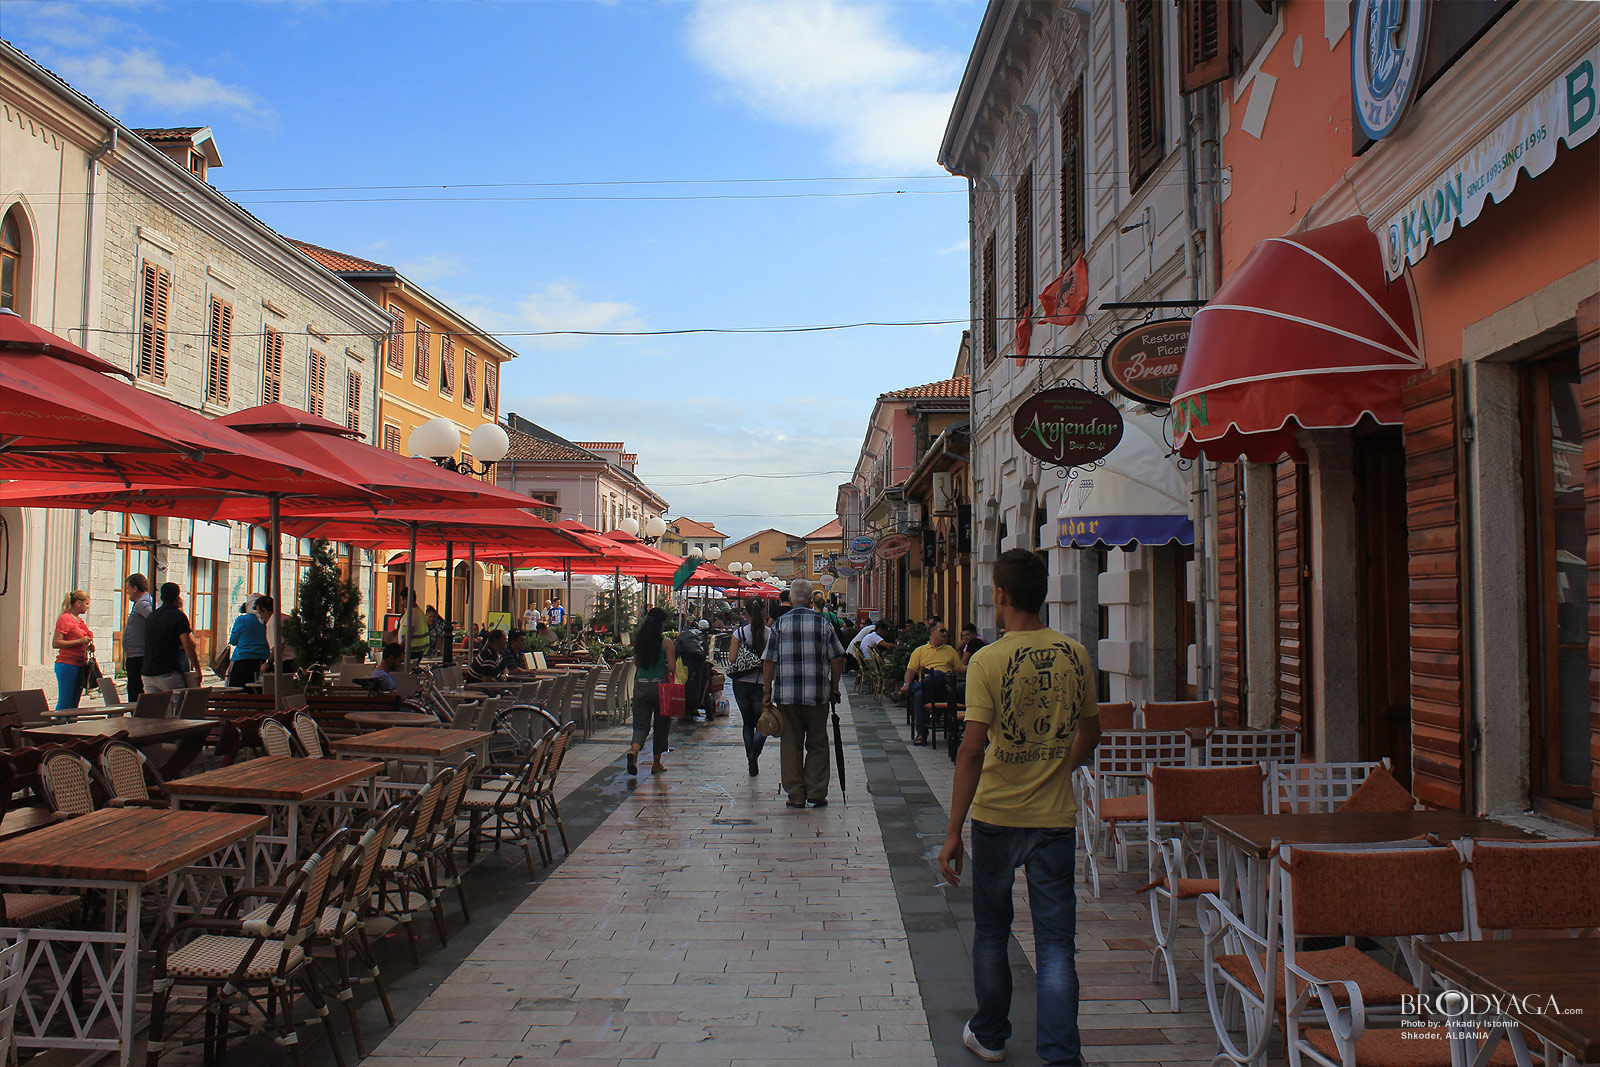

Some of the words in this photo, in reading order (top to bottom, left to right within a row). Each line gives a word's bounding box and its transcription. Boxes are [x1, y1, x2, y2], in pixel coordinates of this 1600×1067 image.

[1467, 174, 1485, 199] SINCE
[1486, 160, 1502, 184] 1995
[1501, 142, 1524, 170] SINCE
[1525, 124, 1548, 151] 1995
[1564, 59, 1600, 137] B
[1123, 351, 1179, 383] Brew
[1020, 411, 1118, 461] Argjendar
